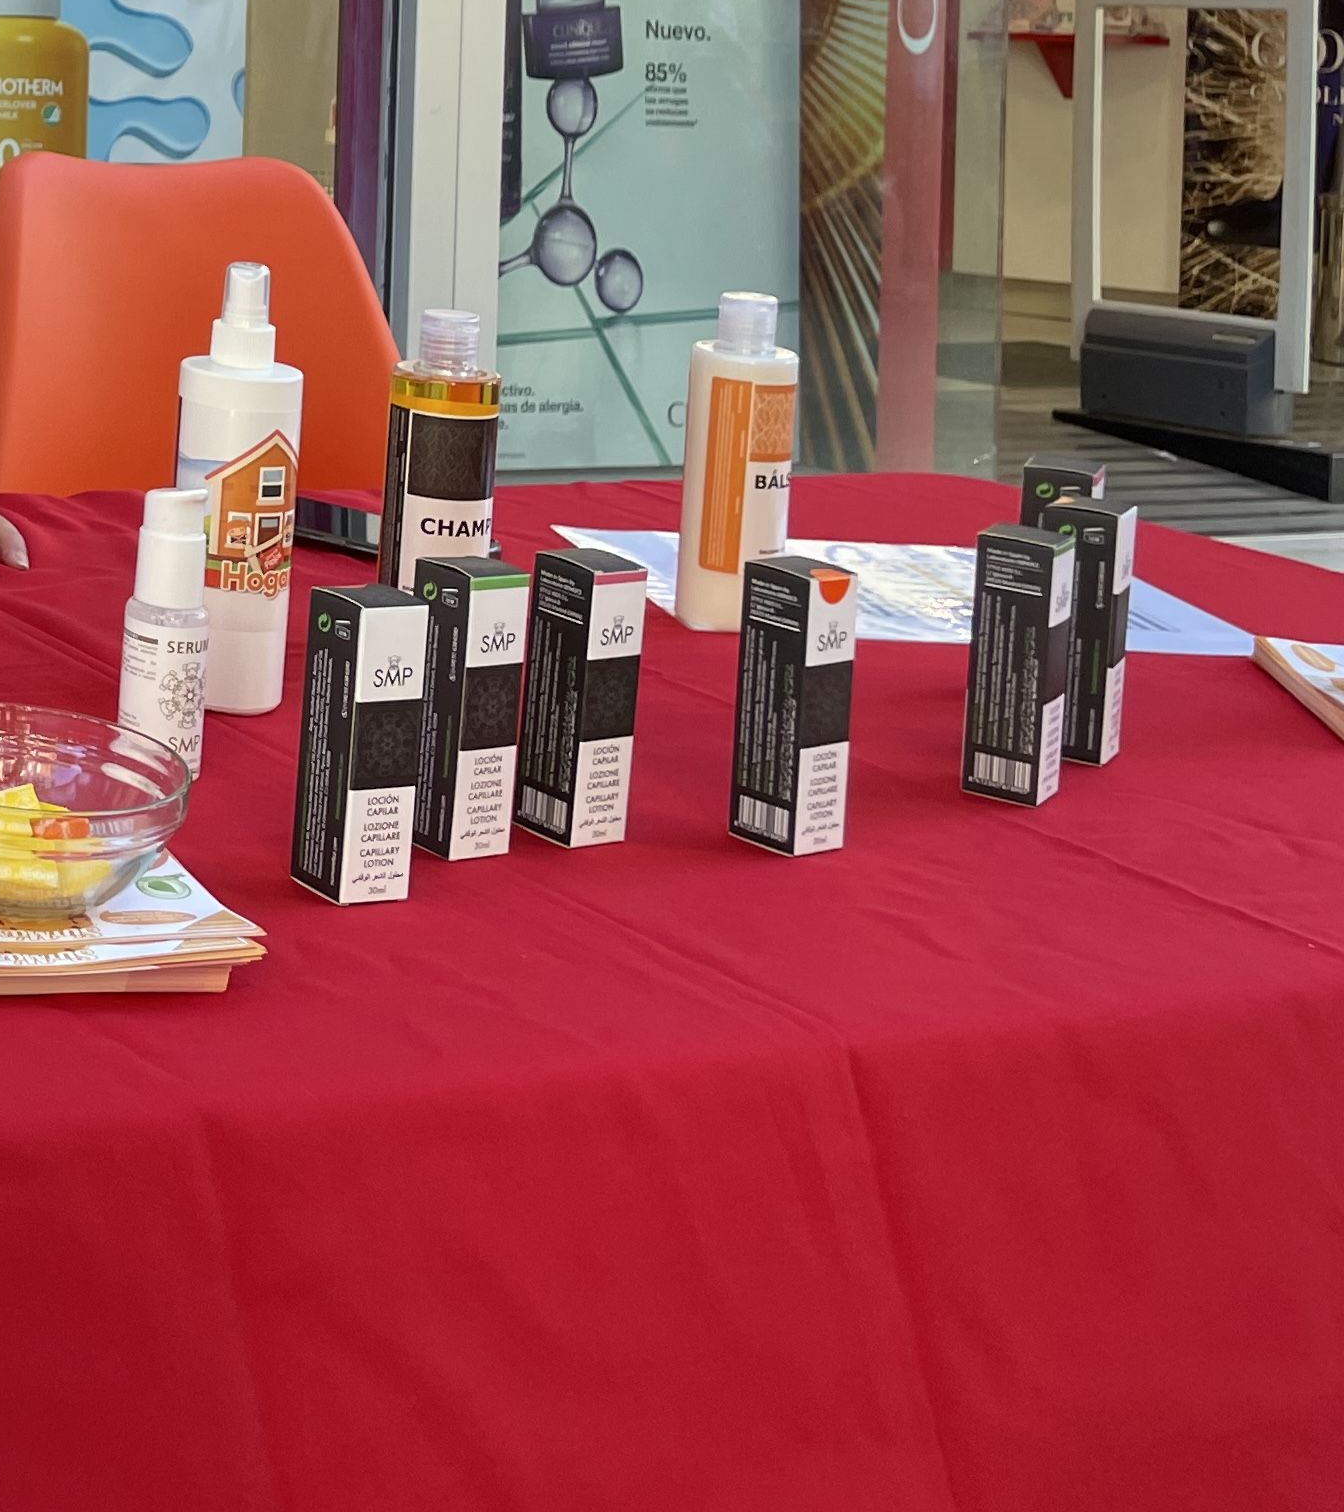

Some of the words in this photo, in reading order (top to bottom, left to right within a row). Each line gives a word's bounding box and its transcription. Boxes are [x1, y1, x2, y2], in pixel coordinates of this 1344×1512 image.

[645, 19, 711, 41] Nuevo.
[645, 62, 687, 83] 85%
[521, 400, 536, 414] de
[539, 398, 584, 415] alergia.
[480, 630, 517, 653] SMP
[600, 626, 634, 645] SMP
[817, 631, 847, 652] SMP
[373, 666, 413, 688] SMP
[168, 734, 200, 753] SMP
[367, 794, 399, 805] LOCIÓN
[366, 807, 398, 816] CAPILAR
[363, 821, 399, 832] LOZIONE
[361, 832, 400, 842] CAPILLARE
[359, 847, 400, 857] CAPILLARY
[363, 859, 394, 868] LOTION
